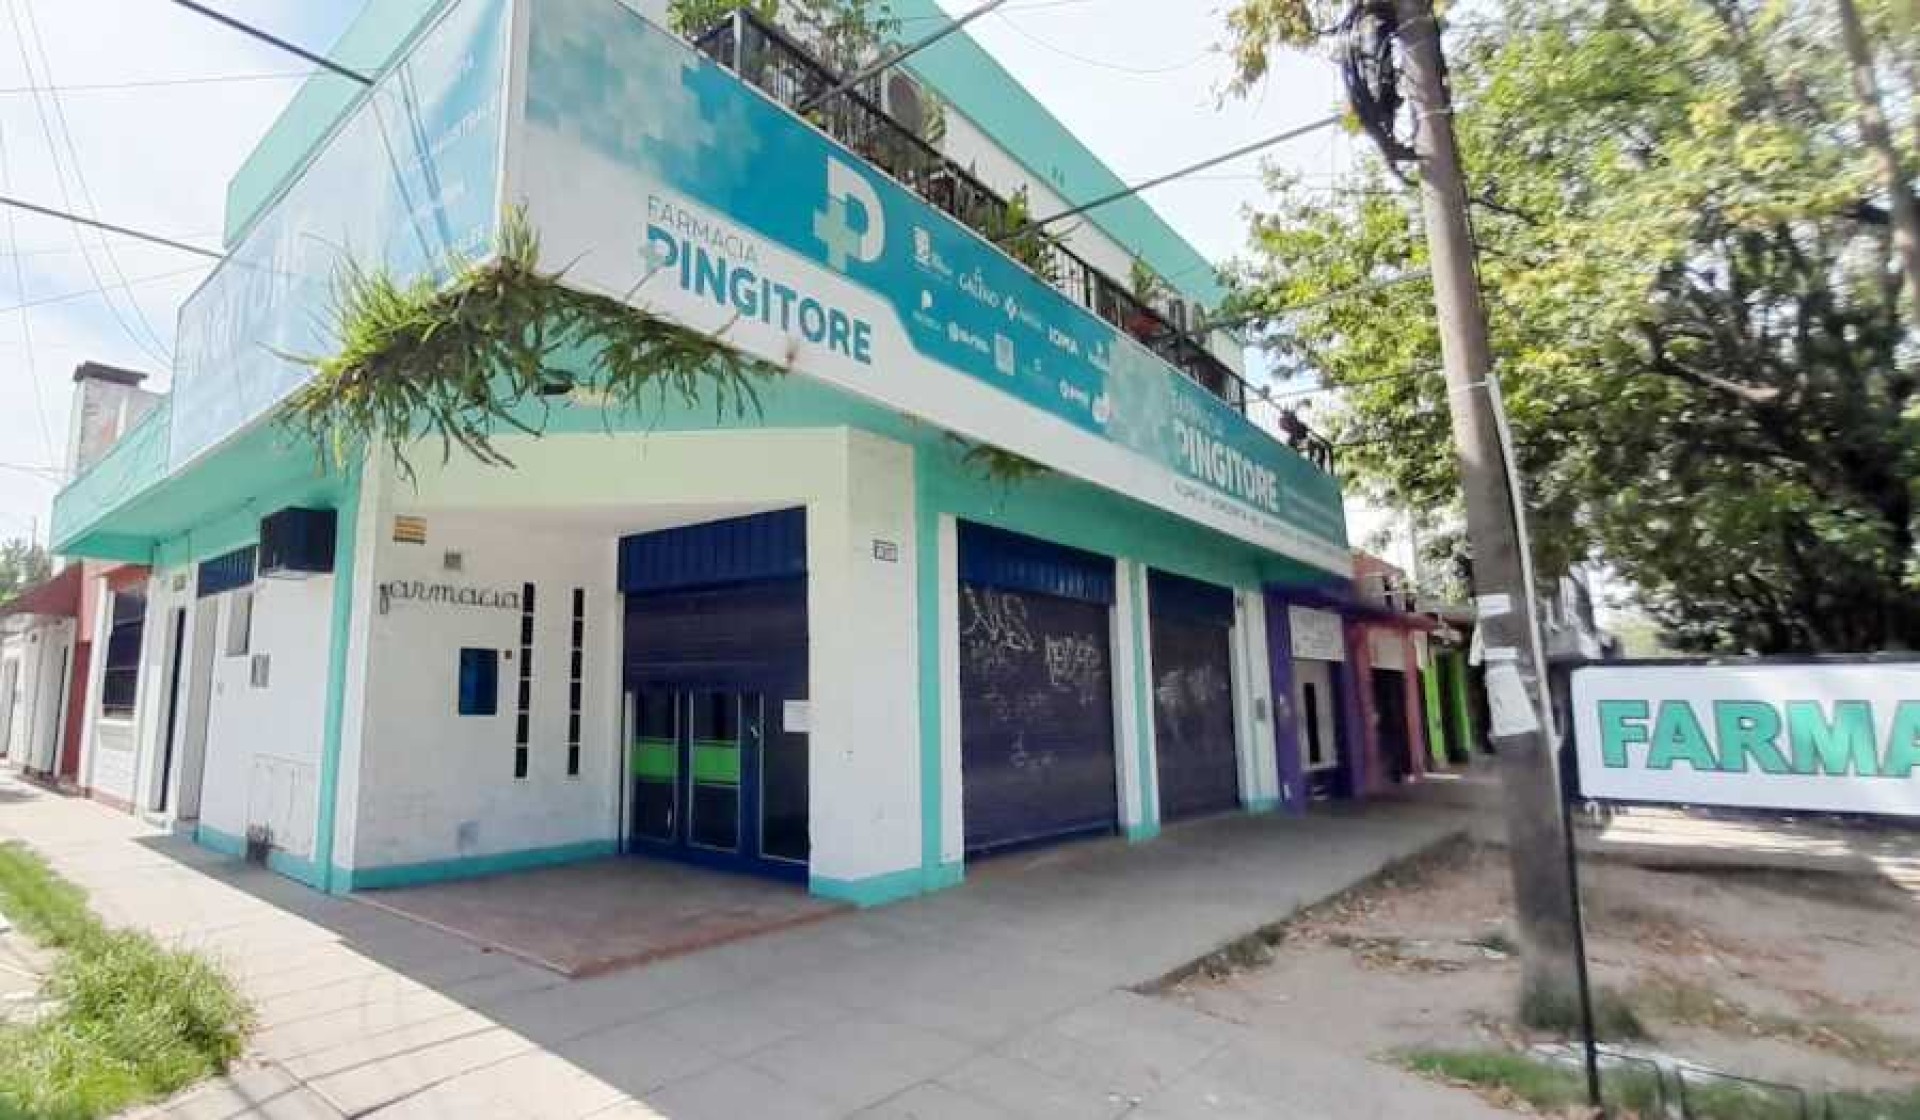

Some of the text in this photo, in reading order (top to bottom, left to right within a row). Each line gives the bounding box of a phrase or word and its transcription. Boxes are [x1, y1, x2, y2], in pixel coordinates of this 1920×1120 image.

[647, 194, 758, 265] FARMACIA
[641, 223, 872, 366] PINGITORE
[1172, 417, 1280, 513] PINGITORE
[378, 578, 520, 615] farmacia
